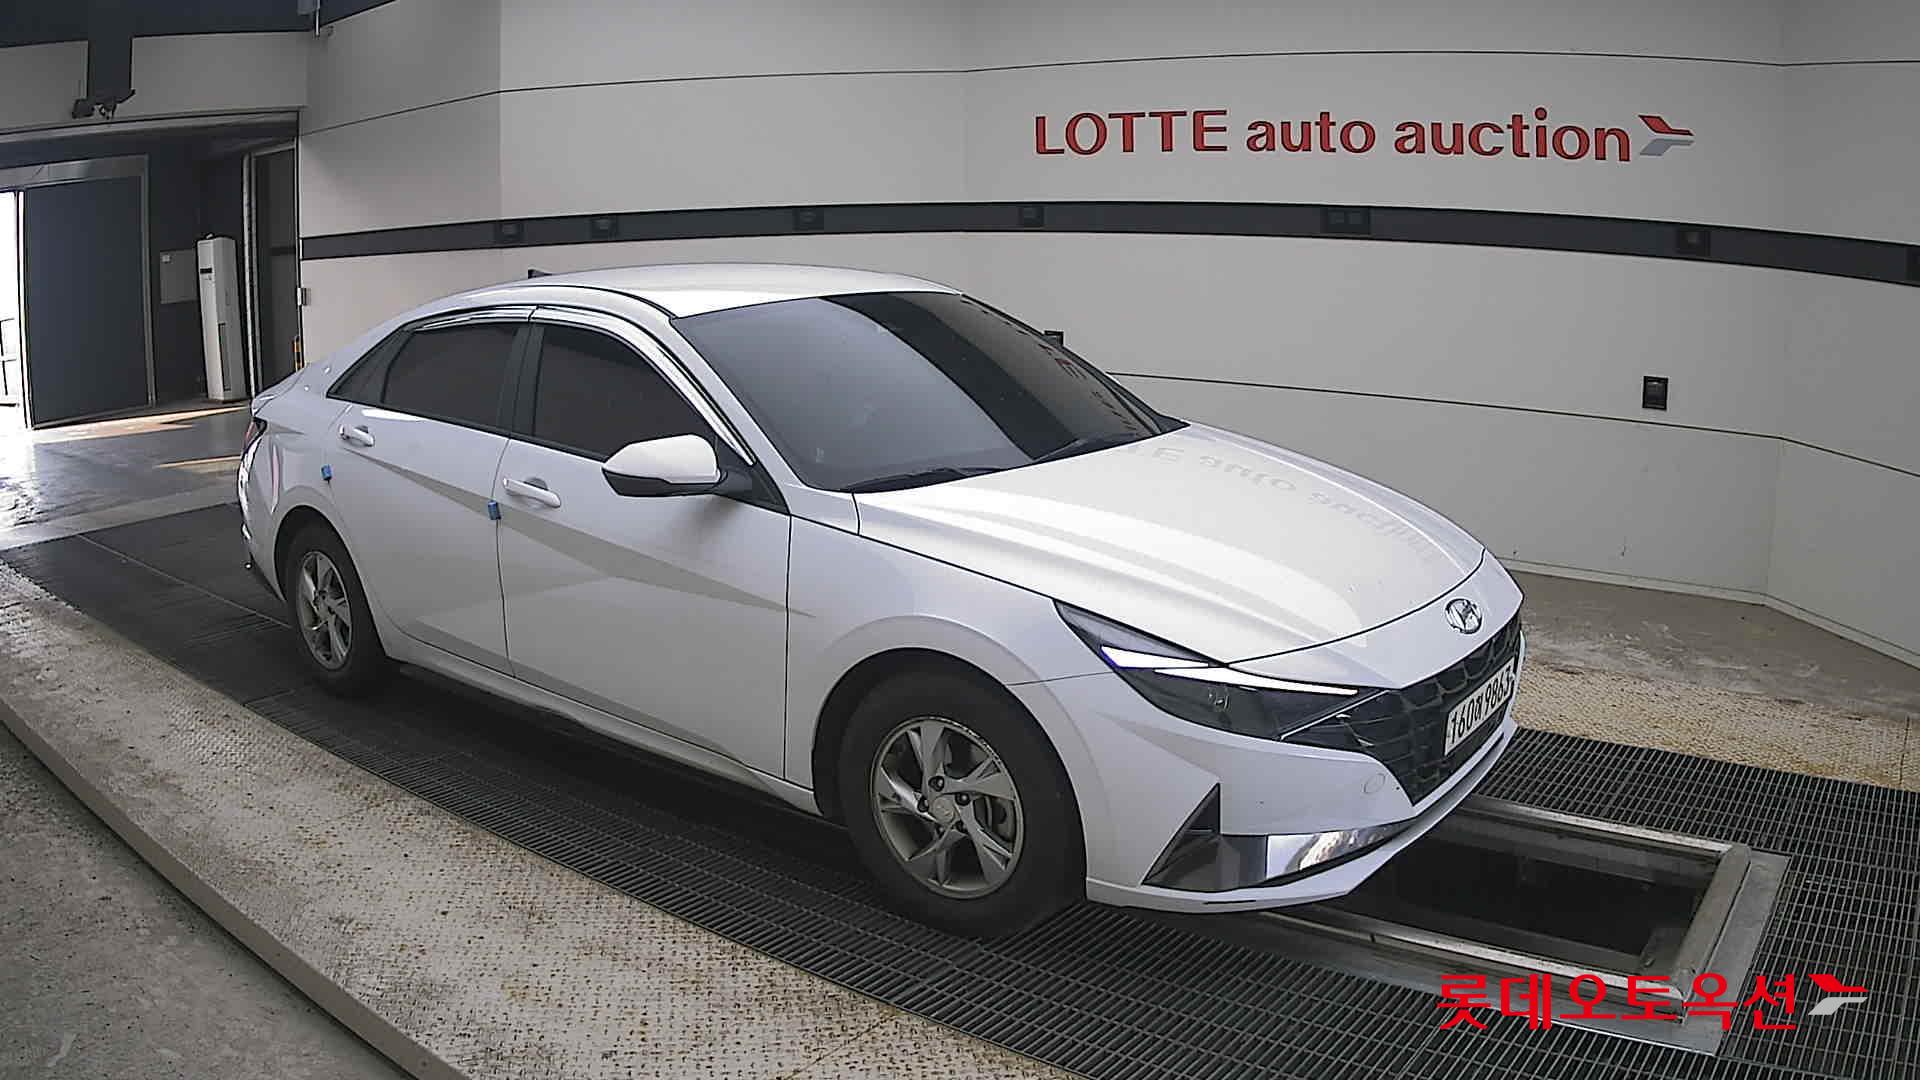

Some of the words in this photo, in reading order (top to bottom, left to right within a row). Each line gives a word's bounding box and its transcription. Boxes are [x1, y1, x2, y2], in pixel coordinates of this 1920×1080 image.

[1035, 109, 1229, 156] LOTTE
[1245, 110, 1377, 155] auto
[1393, 106, 1632, 163] auction
